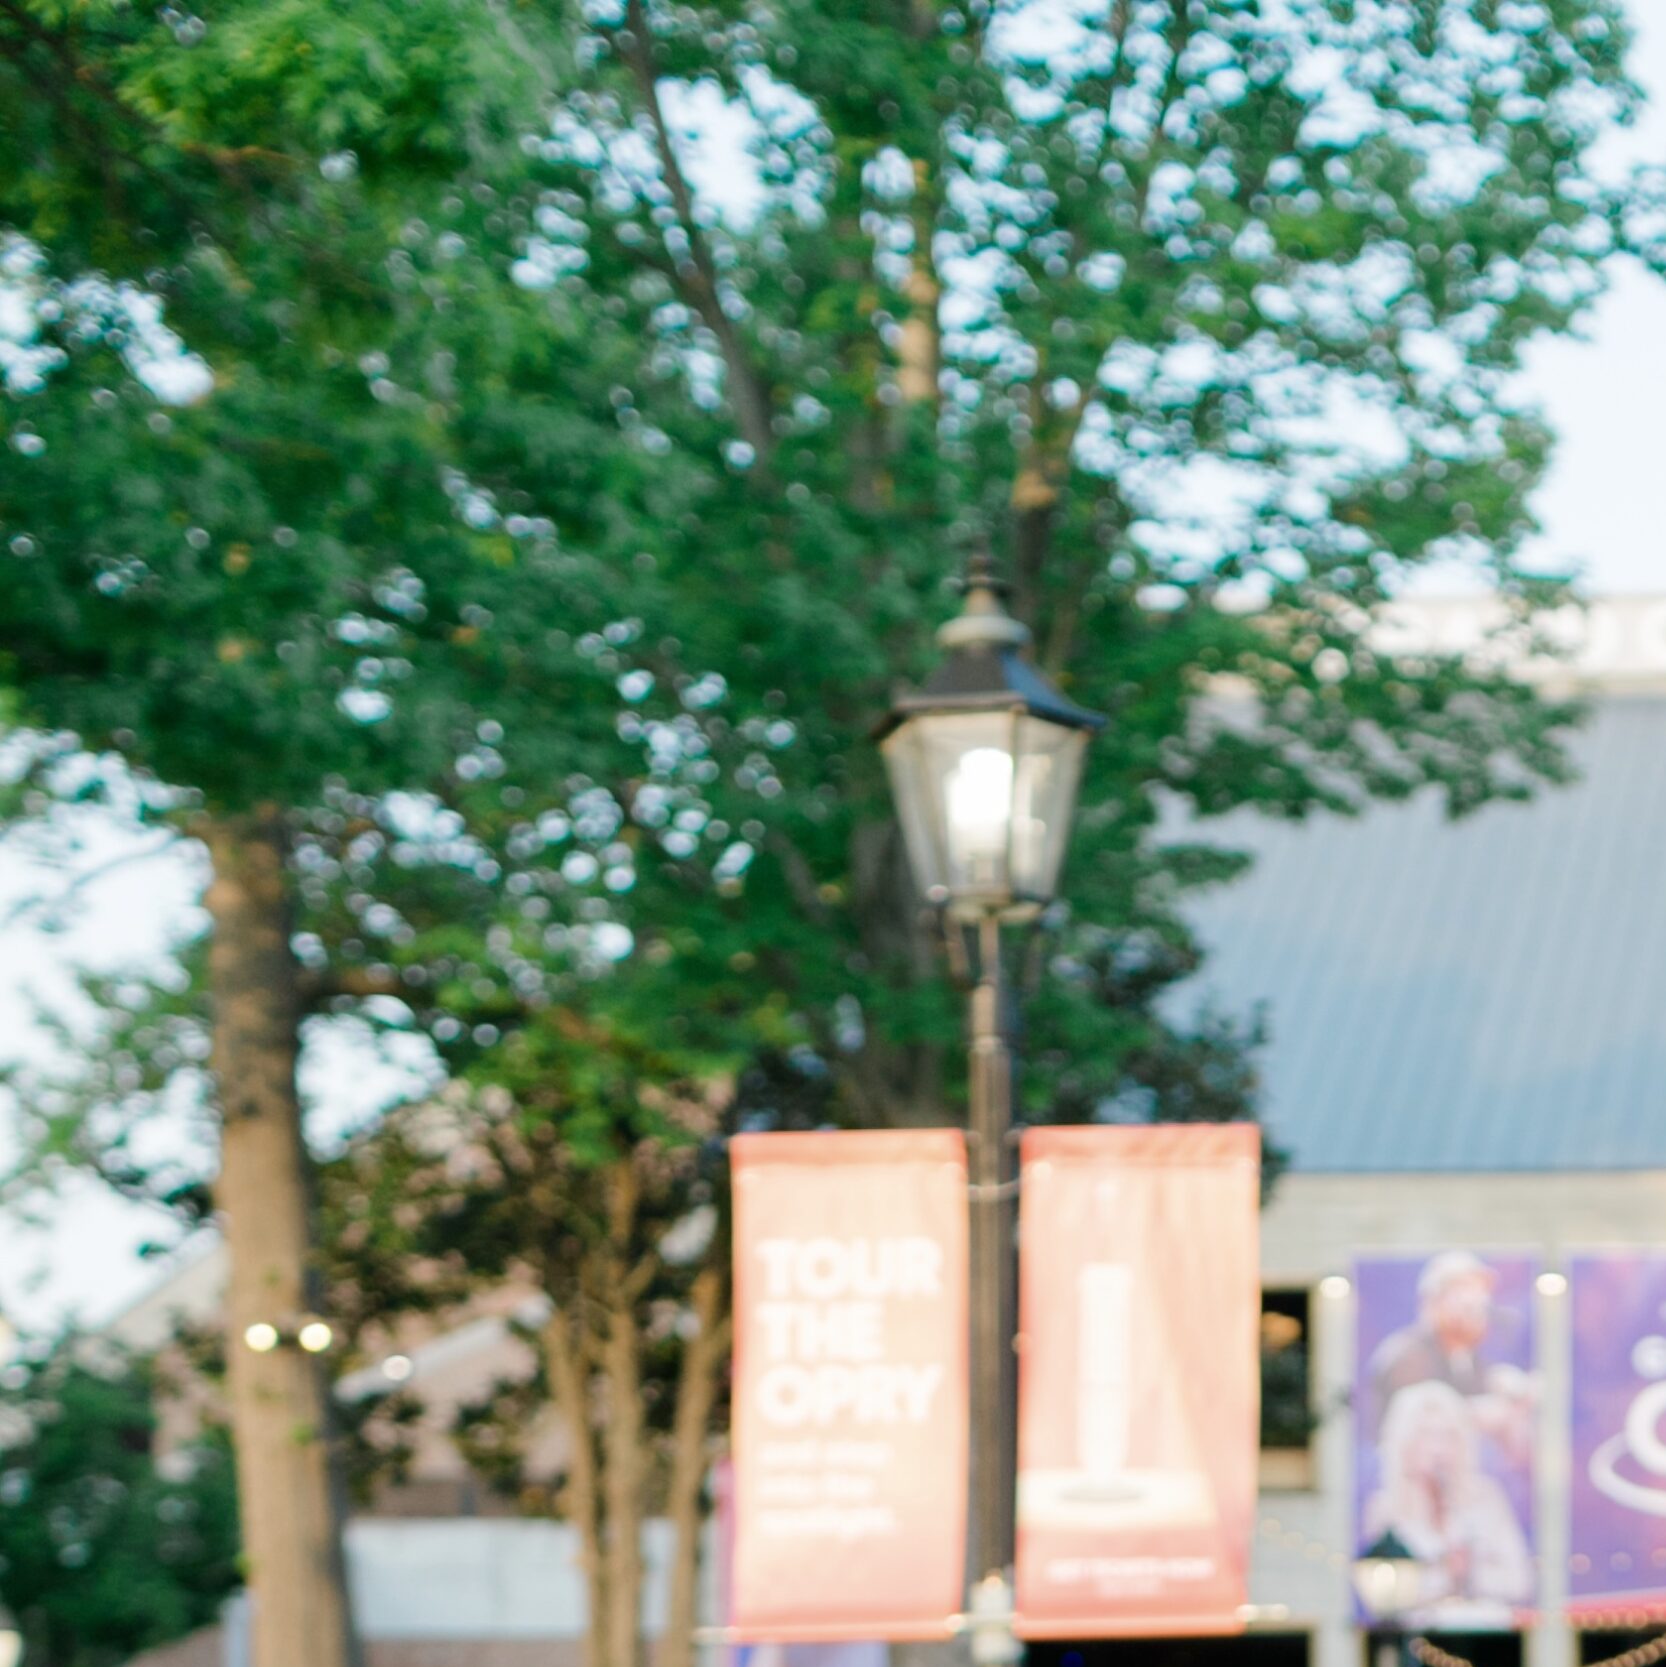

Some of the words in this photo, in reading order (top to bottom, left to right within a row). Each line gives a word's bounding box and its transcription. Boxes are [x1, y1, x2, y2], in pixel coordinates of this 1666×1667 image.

[755, 1237, 944, 1296] TOUR
[755, 1302, 883, 1359] THE
[755, 1363, 944, 1426] OPRY
